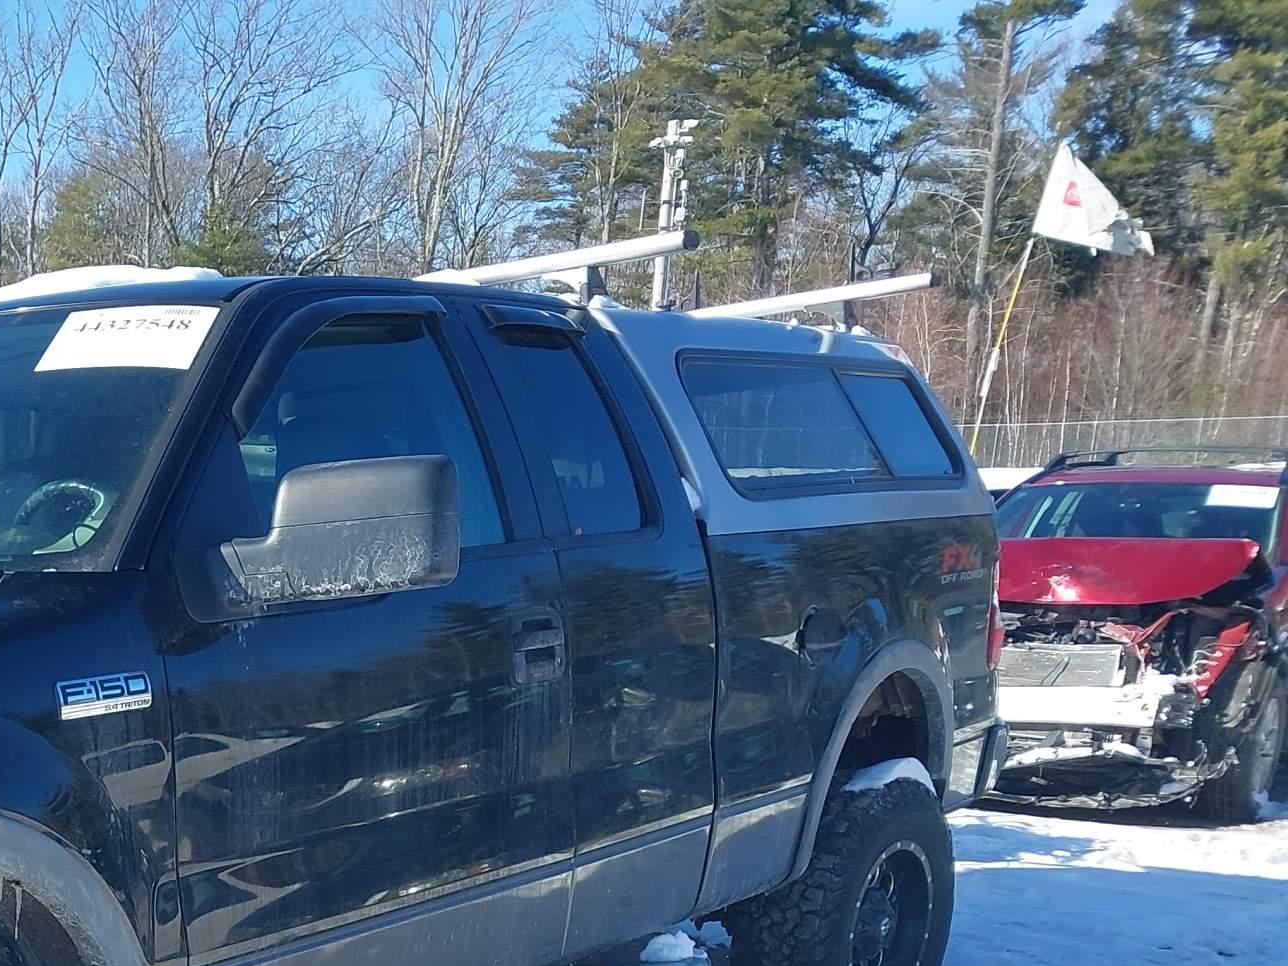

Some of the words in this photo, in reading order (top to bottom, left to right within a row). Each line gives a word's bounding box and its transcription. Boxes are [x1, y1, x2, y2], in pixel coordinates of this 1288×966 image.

[73, 318, 192, 334] 44327548
[942, 544, 982, 575] FX4
[941, 573, 959, 584] OFF
[960, 569, 983, 580] ROAD
[59, 673, 150, 706] F-150
[104, 703, 118, 712] 5.4
[119, 698, 150, 710] TRITON
